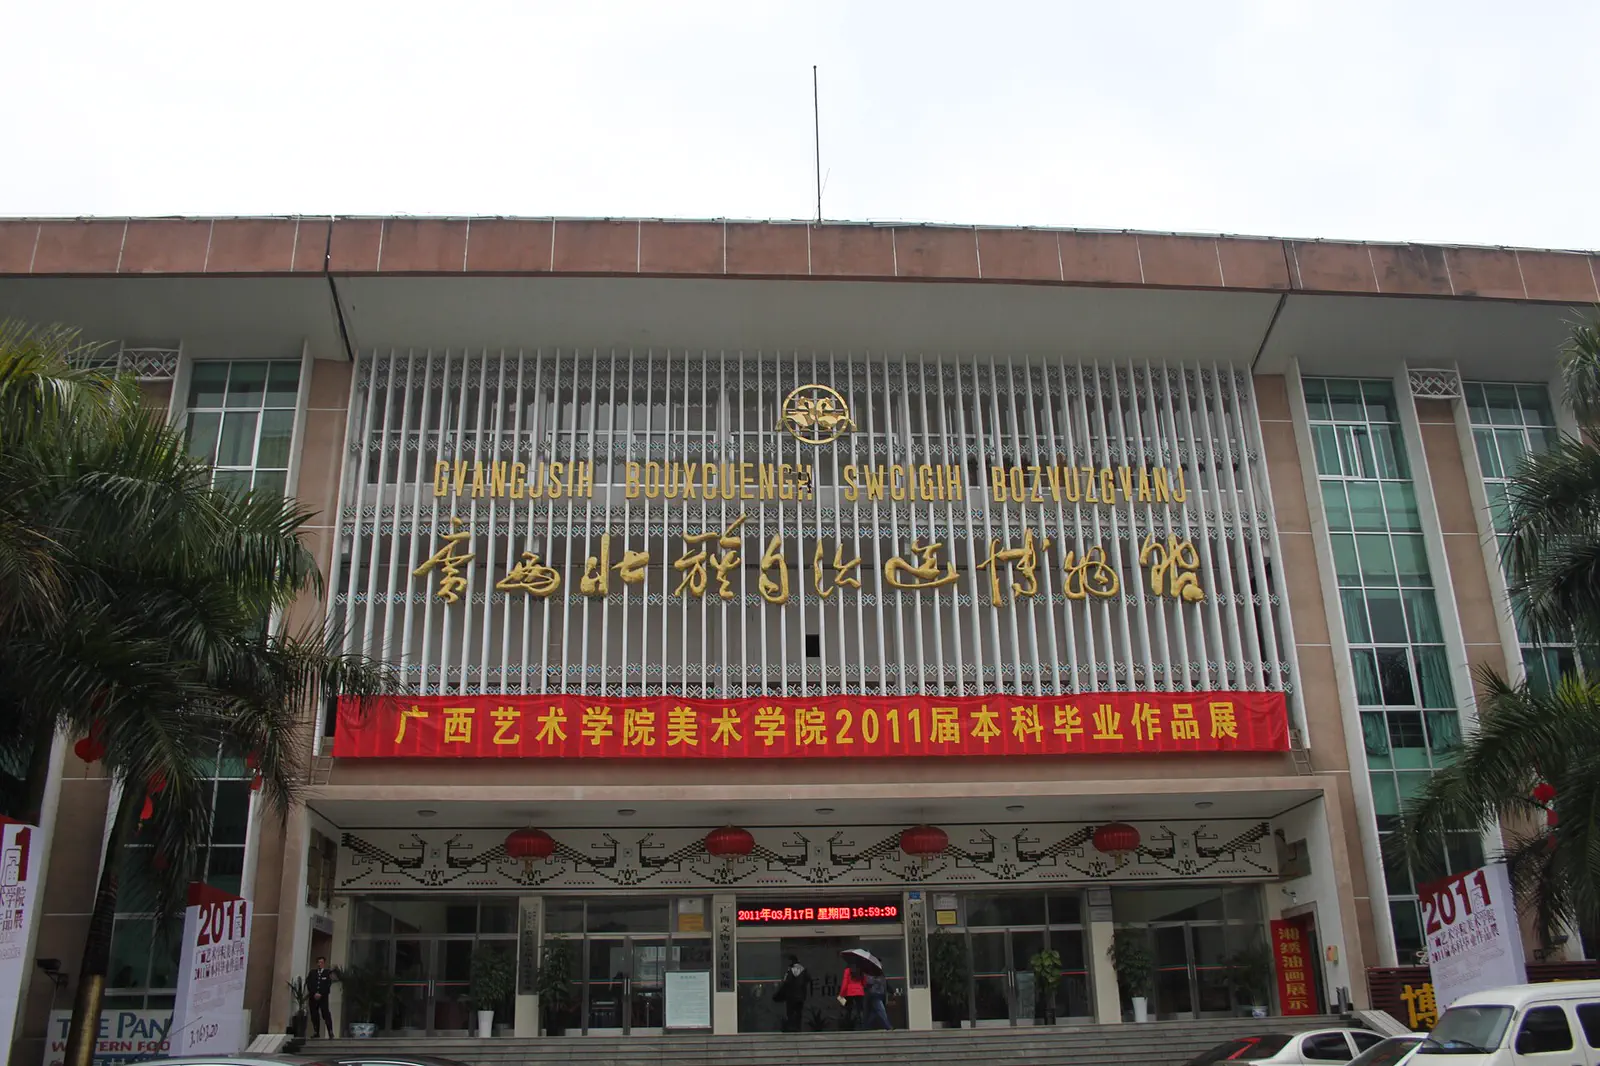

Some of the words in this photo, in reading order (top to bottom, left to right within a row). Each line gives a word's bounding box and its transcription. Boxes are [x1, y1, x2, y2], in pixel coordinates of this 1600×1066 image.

[433, 460, 594, 499] GVANGJSIH
[843, 463, 962, 502] SWCIGIH
[991, 466, 1187, 505] BOZVUZGVANJ
[395, 701, 1238, 746] 广西艺术学院美术学院2011届本科毕业作品展
[197, 901, 247, 947] 2011
[738, 908, 815, 922] 2011年03月17日
[817, 907, 850, 920] 星期四
[852, 906, 897, 918] 16:59:30
[1421, 870, 1492, 936] 2011
[57, 1018, 109, 1039] TE
